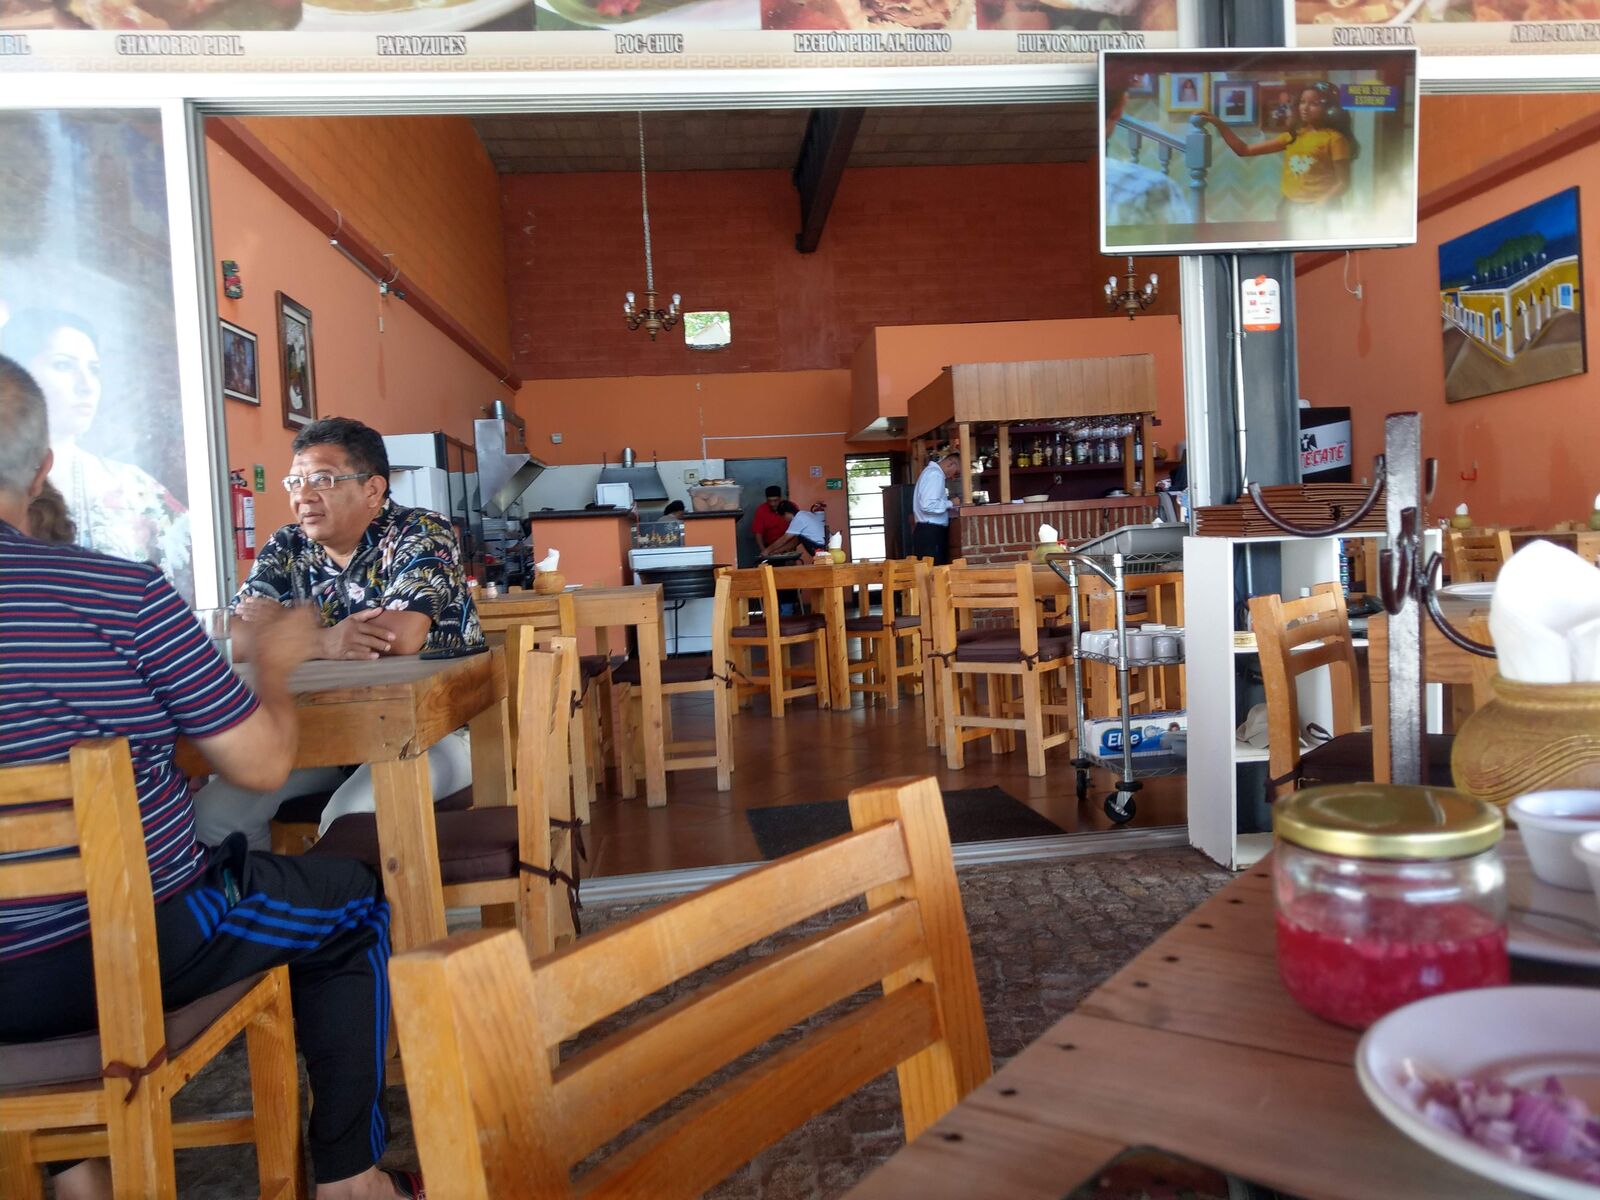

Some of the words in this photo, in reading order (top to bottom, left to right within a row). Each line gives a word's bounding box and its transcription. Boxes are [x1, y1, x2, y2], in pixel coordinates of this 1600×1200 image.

[615, 34, 684, 53] POC-CHUC
[794, 31, 849, 52] LECHÓN
[849, 33, 884, 52] PIBIL
[885, 33, 904, 52] AL
[905, 33, 952, 52] HORNO
[1017, 34, 1068, 52] HUEVOS
[1068, 31, 1145, 53] MOTULEÑOS
[1333, 27, 1363, 46] SOPA
[1363, 27, 1382, 45] DE
[1510, 24, 1553, 43] ARROZ
[117, 34, 200, 55] CHAMORRO
[203, 35, 245, 55] PIBIL
[377, 35, 467, 55] PAPADZULES
